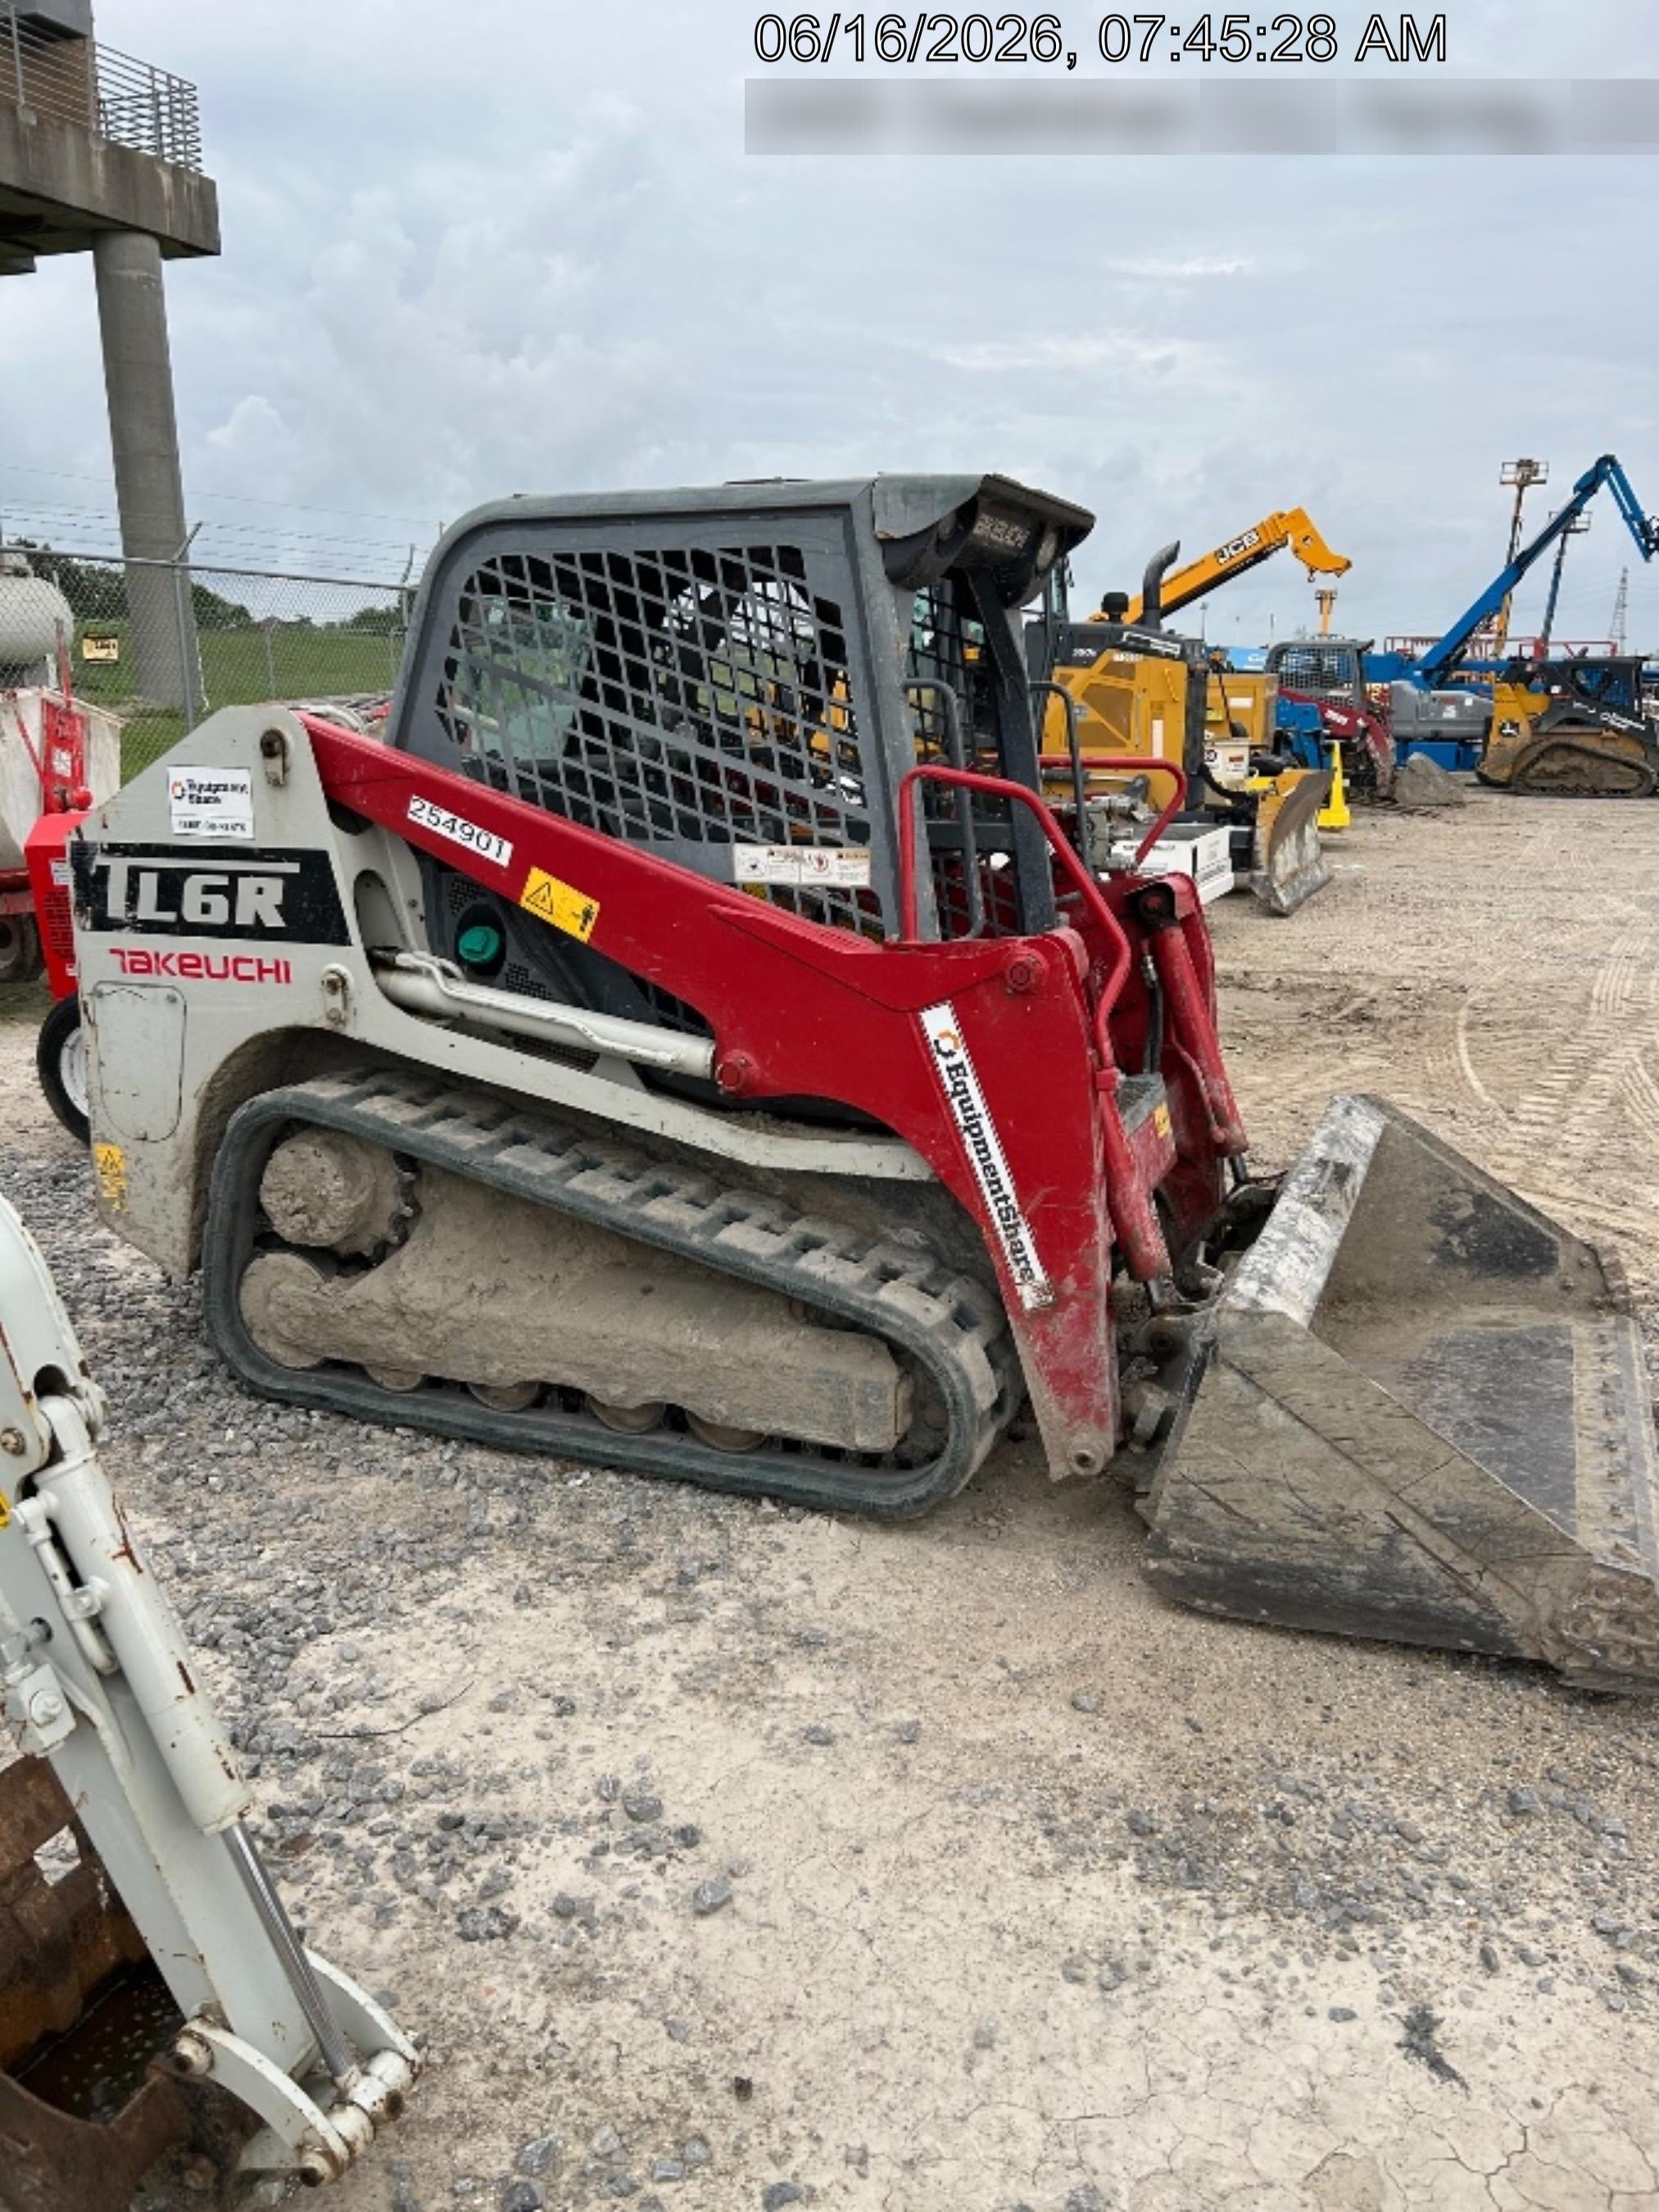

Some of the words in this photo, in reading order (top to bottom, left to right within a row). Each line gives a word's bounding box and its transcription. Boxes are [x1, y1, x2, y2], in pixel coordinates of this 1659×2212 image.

[1218, 530, 1259, 564] JCB
[410, 798, 504, 859] 254901
[92, 856, 301, 927] TL6R
[945, 1063, 1036, 1281] EquipmentShare
